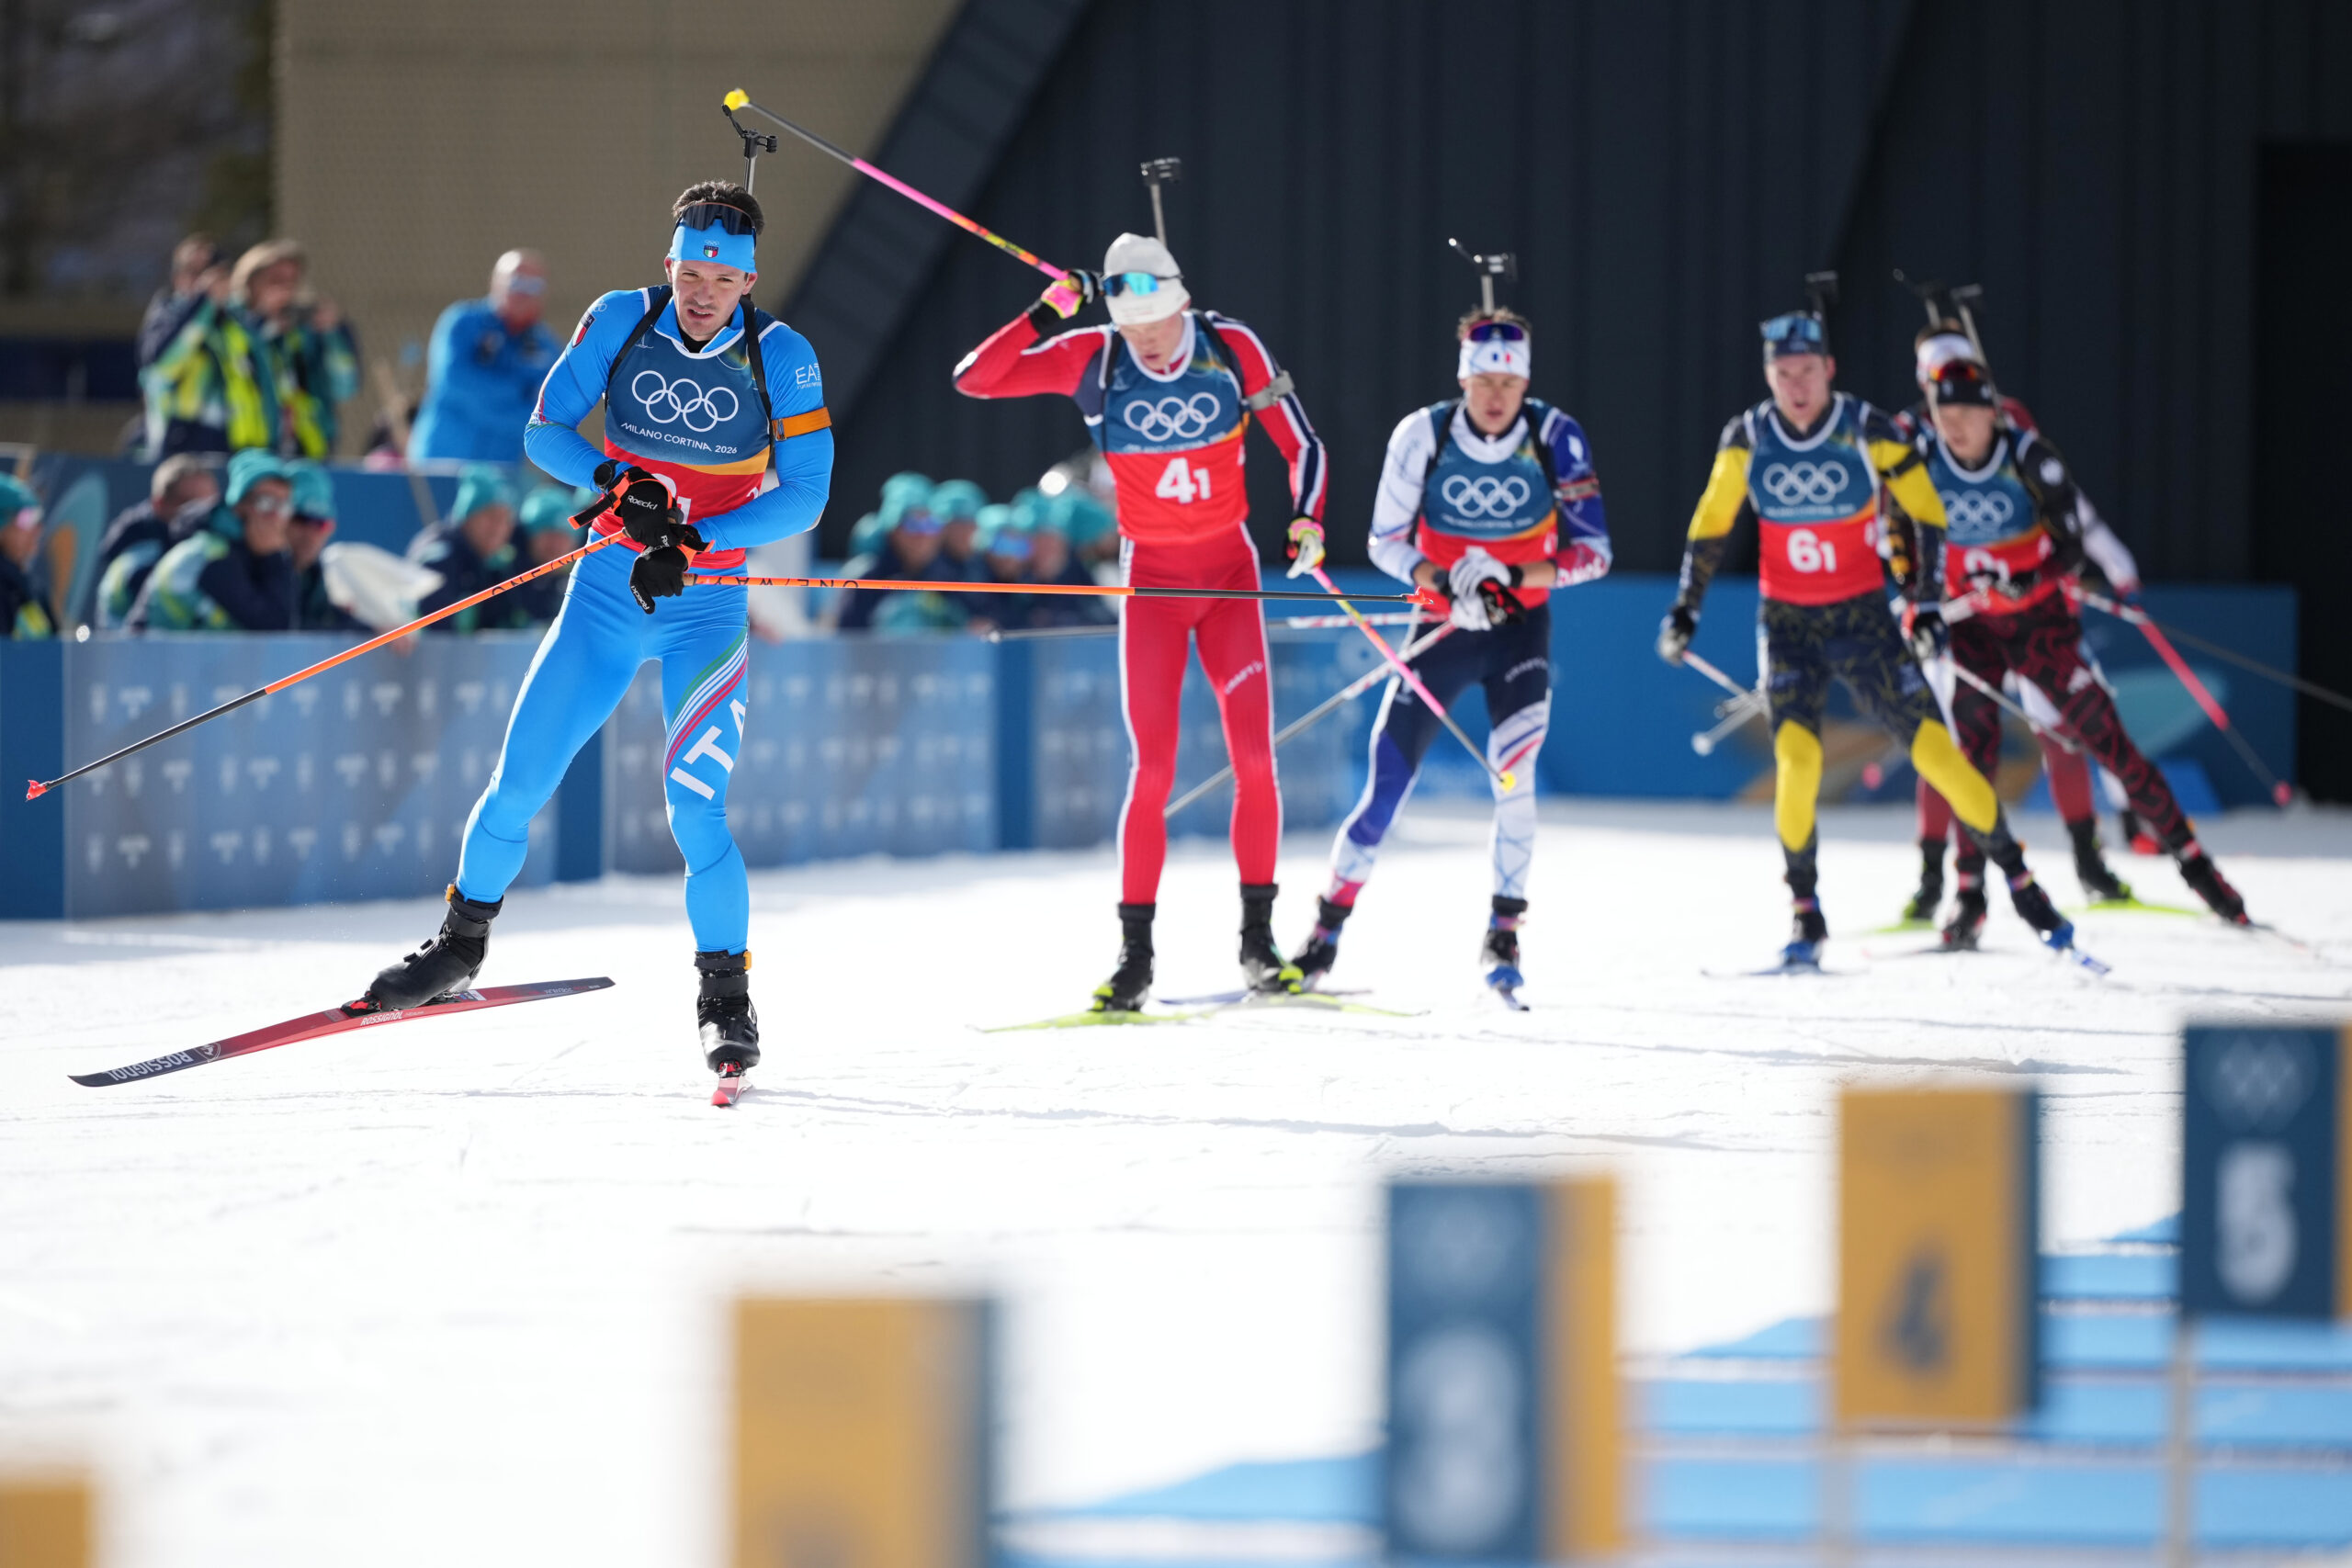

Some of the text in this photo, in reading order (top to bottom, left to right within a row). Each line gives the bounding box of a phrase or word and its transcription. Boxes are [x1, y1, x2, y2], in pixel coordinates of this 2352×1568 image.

[621, 423, 738, 454] MILANO CORTINA 2026
[361, 1010, 403, 1026] ROSSIGNOL
[103, 1050, 194, 1081] ROSSIGNOL
